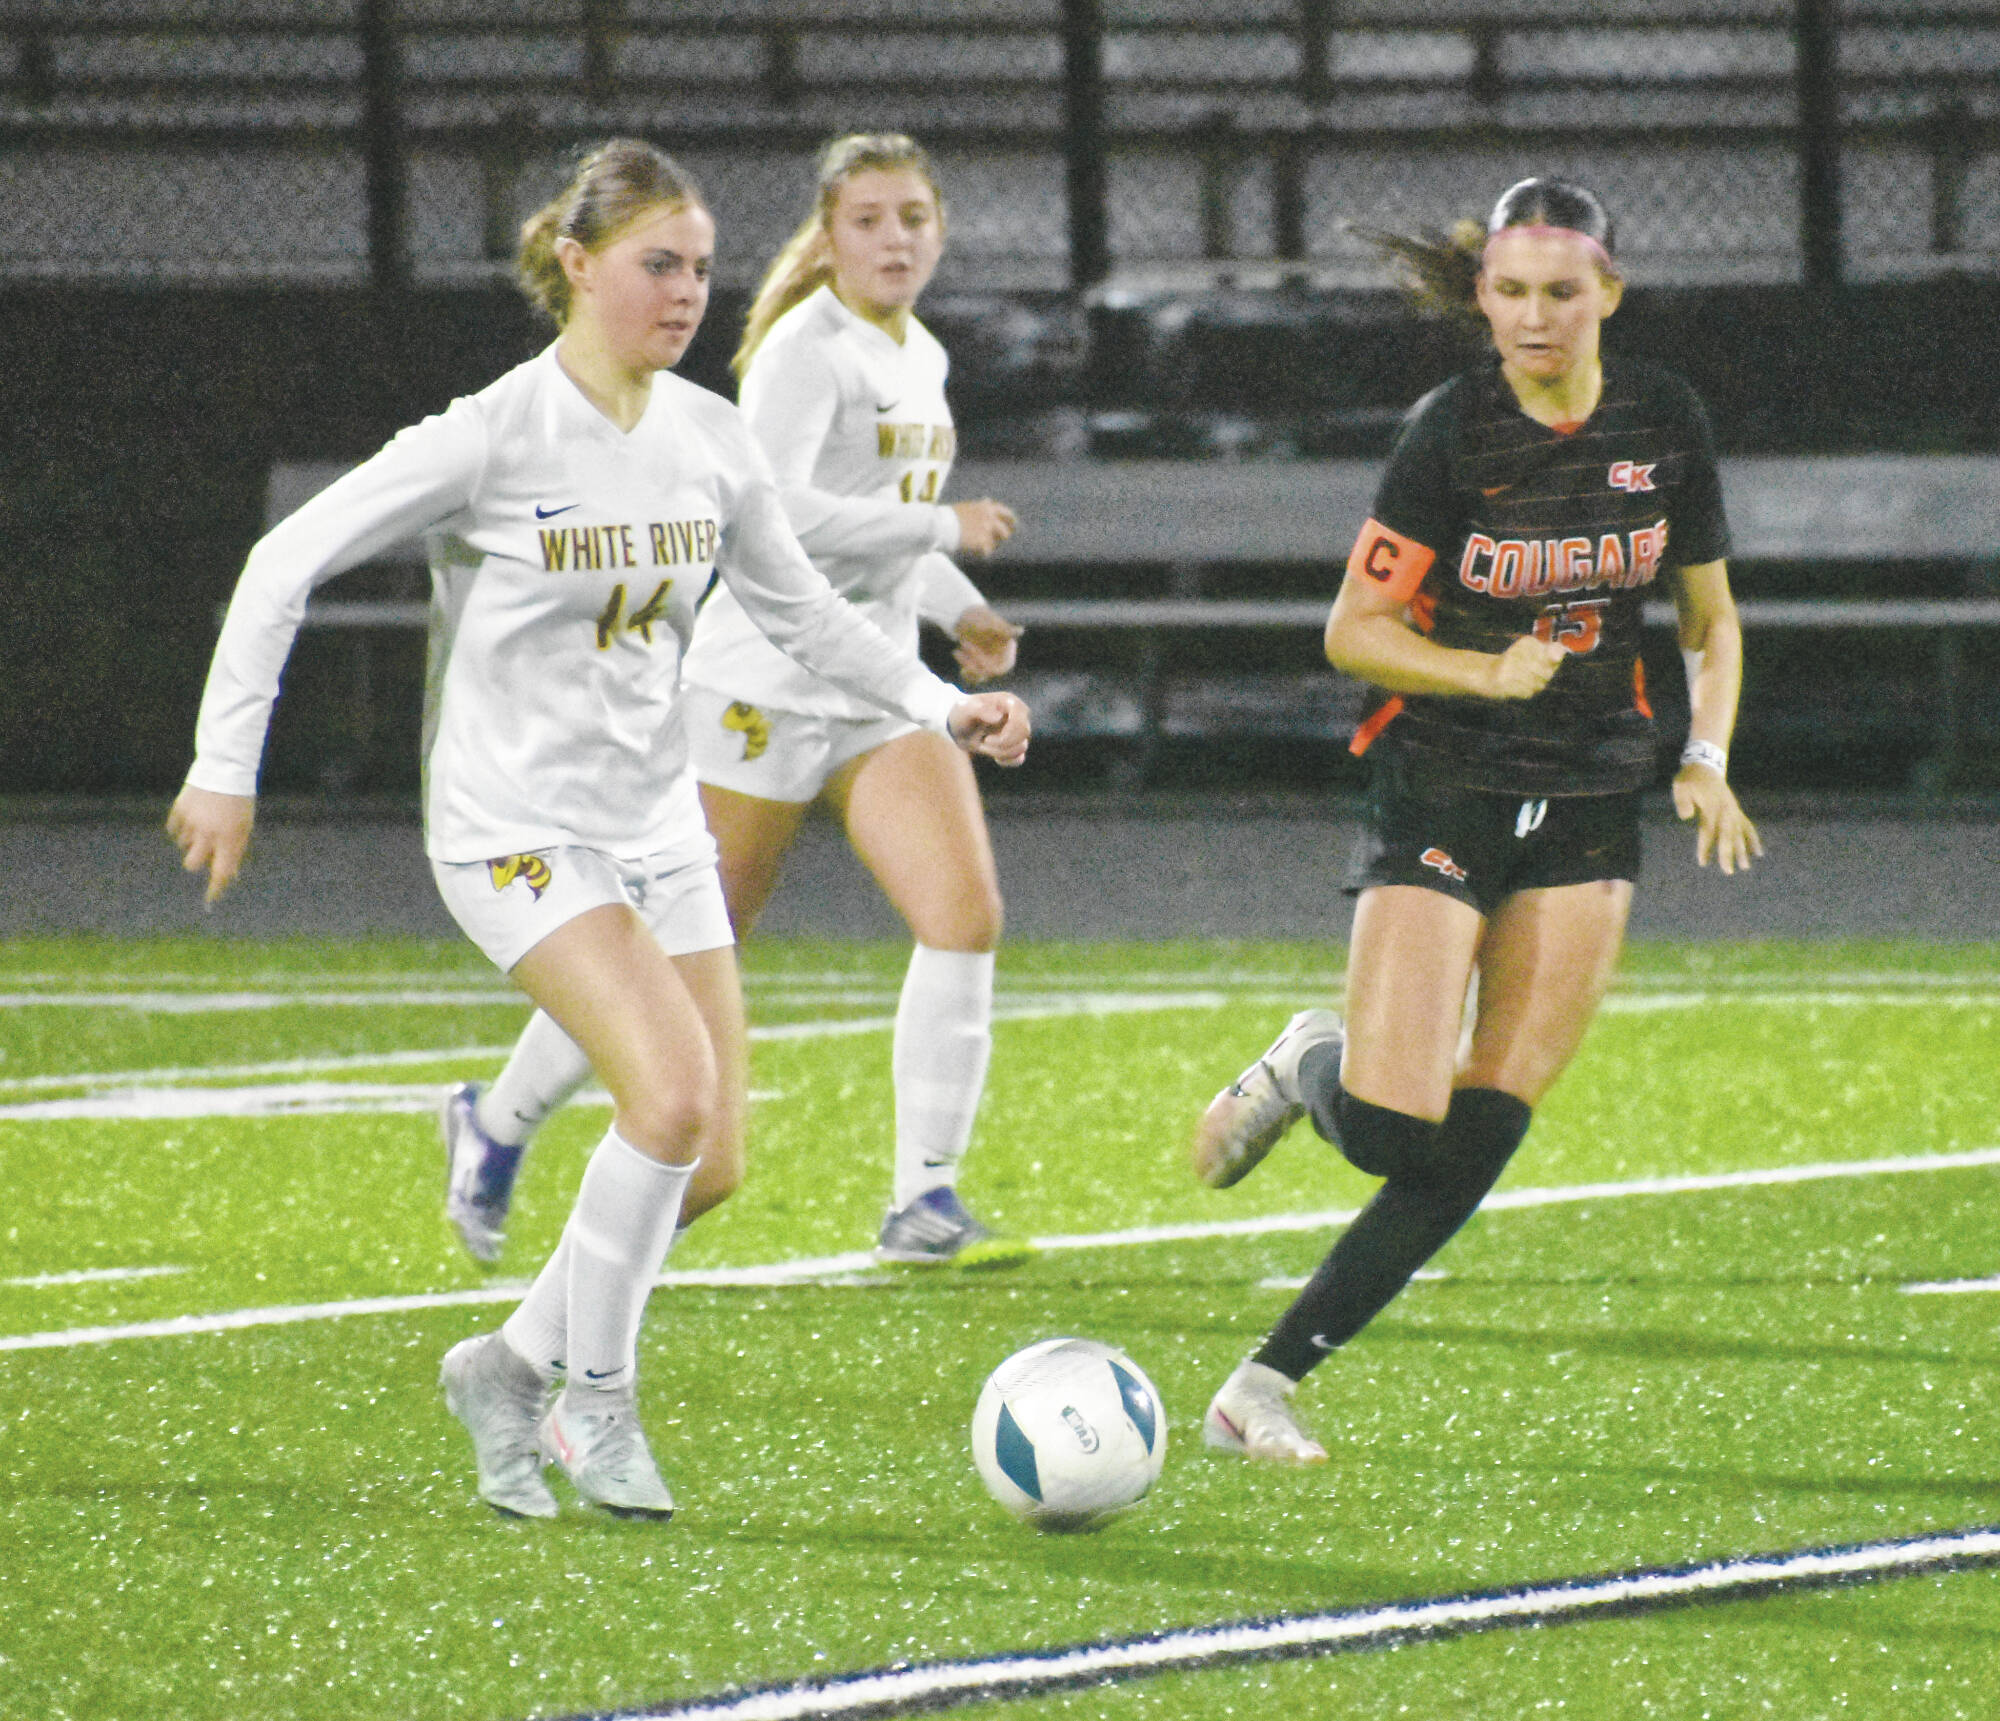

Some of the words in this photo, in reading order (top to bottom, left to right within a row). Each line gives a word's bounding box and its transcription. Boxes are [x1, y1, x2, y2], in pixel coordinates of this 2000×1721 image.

[1608, 460, 1657, 493] CK
[538, 524, 637, 572] WHITE
[648, 518, 717, 566] RIVER
[1364, 535, 1400, 582] C
[596, 577, 674, 652] 14
[1532, 597, 1613, 655] 15
